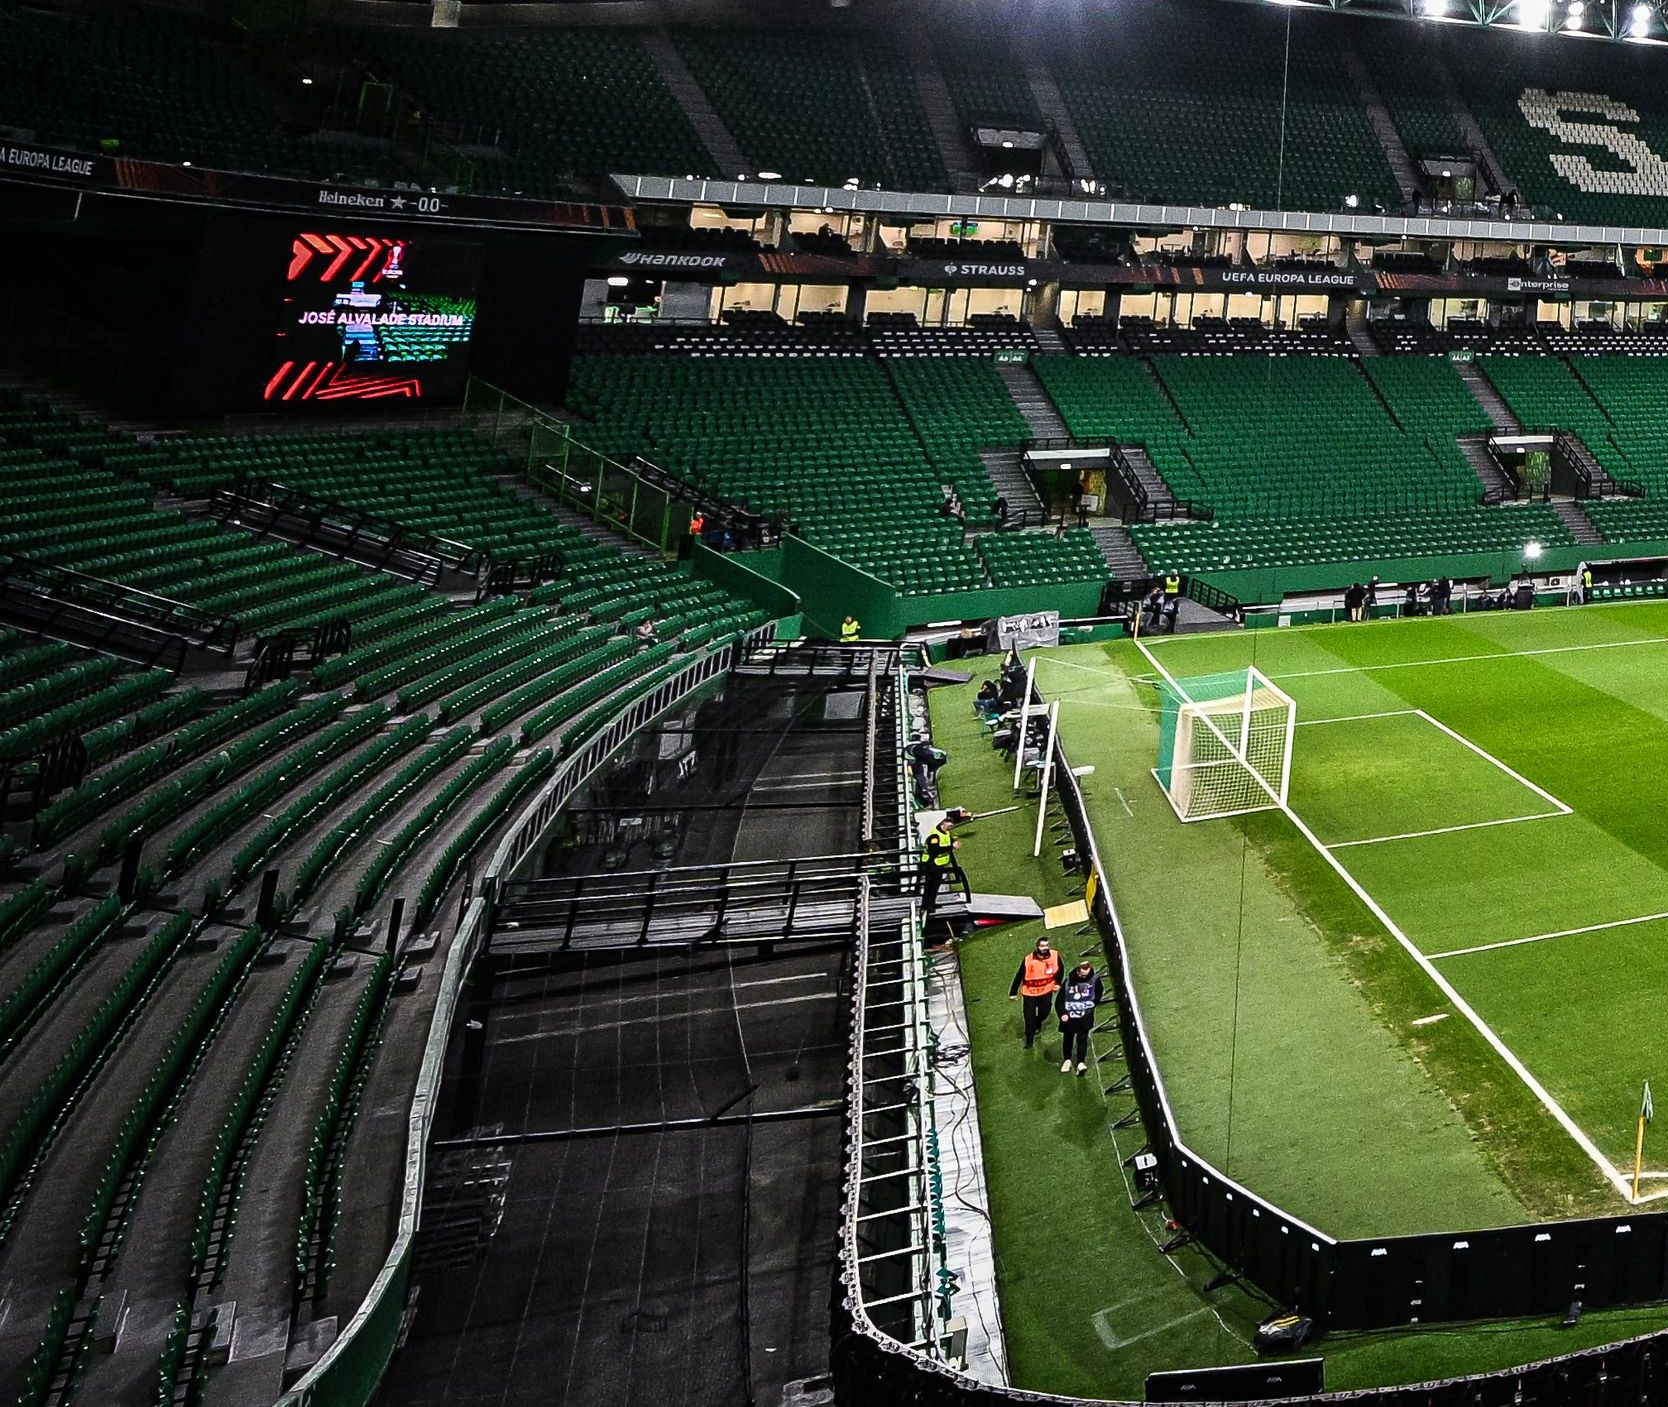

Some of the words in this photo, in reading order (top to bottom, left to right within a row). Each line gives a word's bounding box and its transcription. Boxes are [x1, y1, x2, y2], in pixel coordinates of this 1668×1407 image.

[8, 148, 50, 169] EUROPA
[52, 155, 92, 176] LEAGUE
[319, 191, 385, 207] Heineken
[960, 265, 1025, 276] STRAUSS
[1222, 272, 1255, 282] UEFA
[1258, 273, 1305, 283] EUROPA
[1308, 275, 1354, 284] LEAGUE
[298, 309, 337, 325] JOSÉ
[337, 312, 407, 326] ALVALADE
[407, 313, 464, 327] STADIUM
